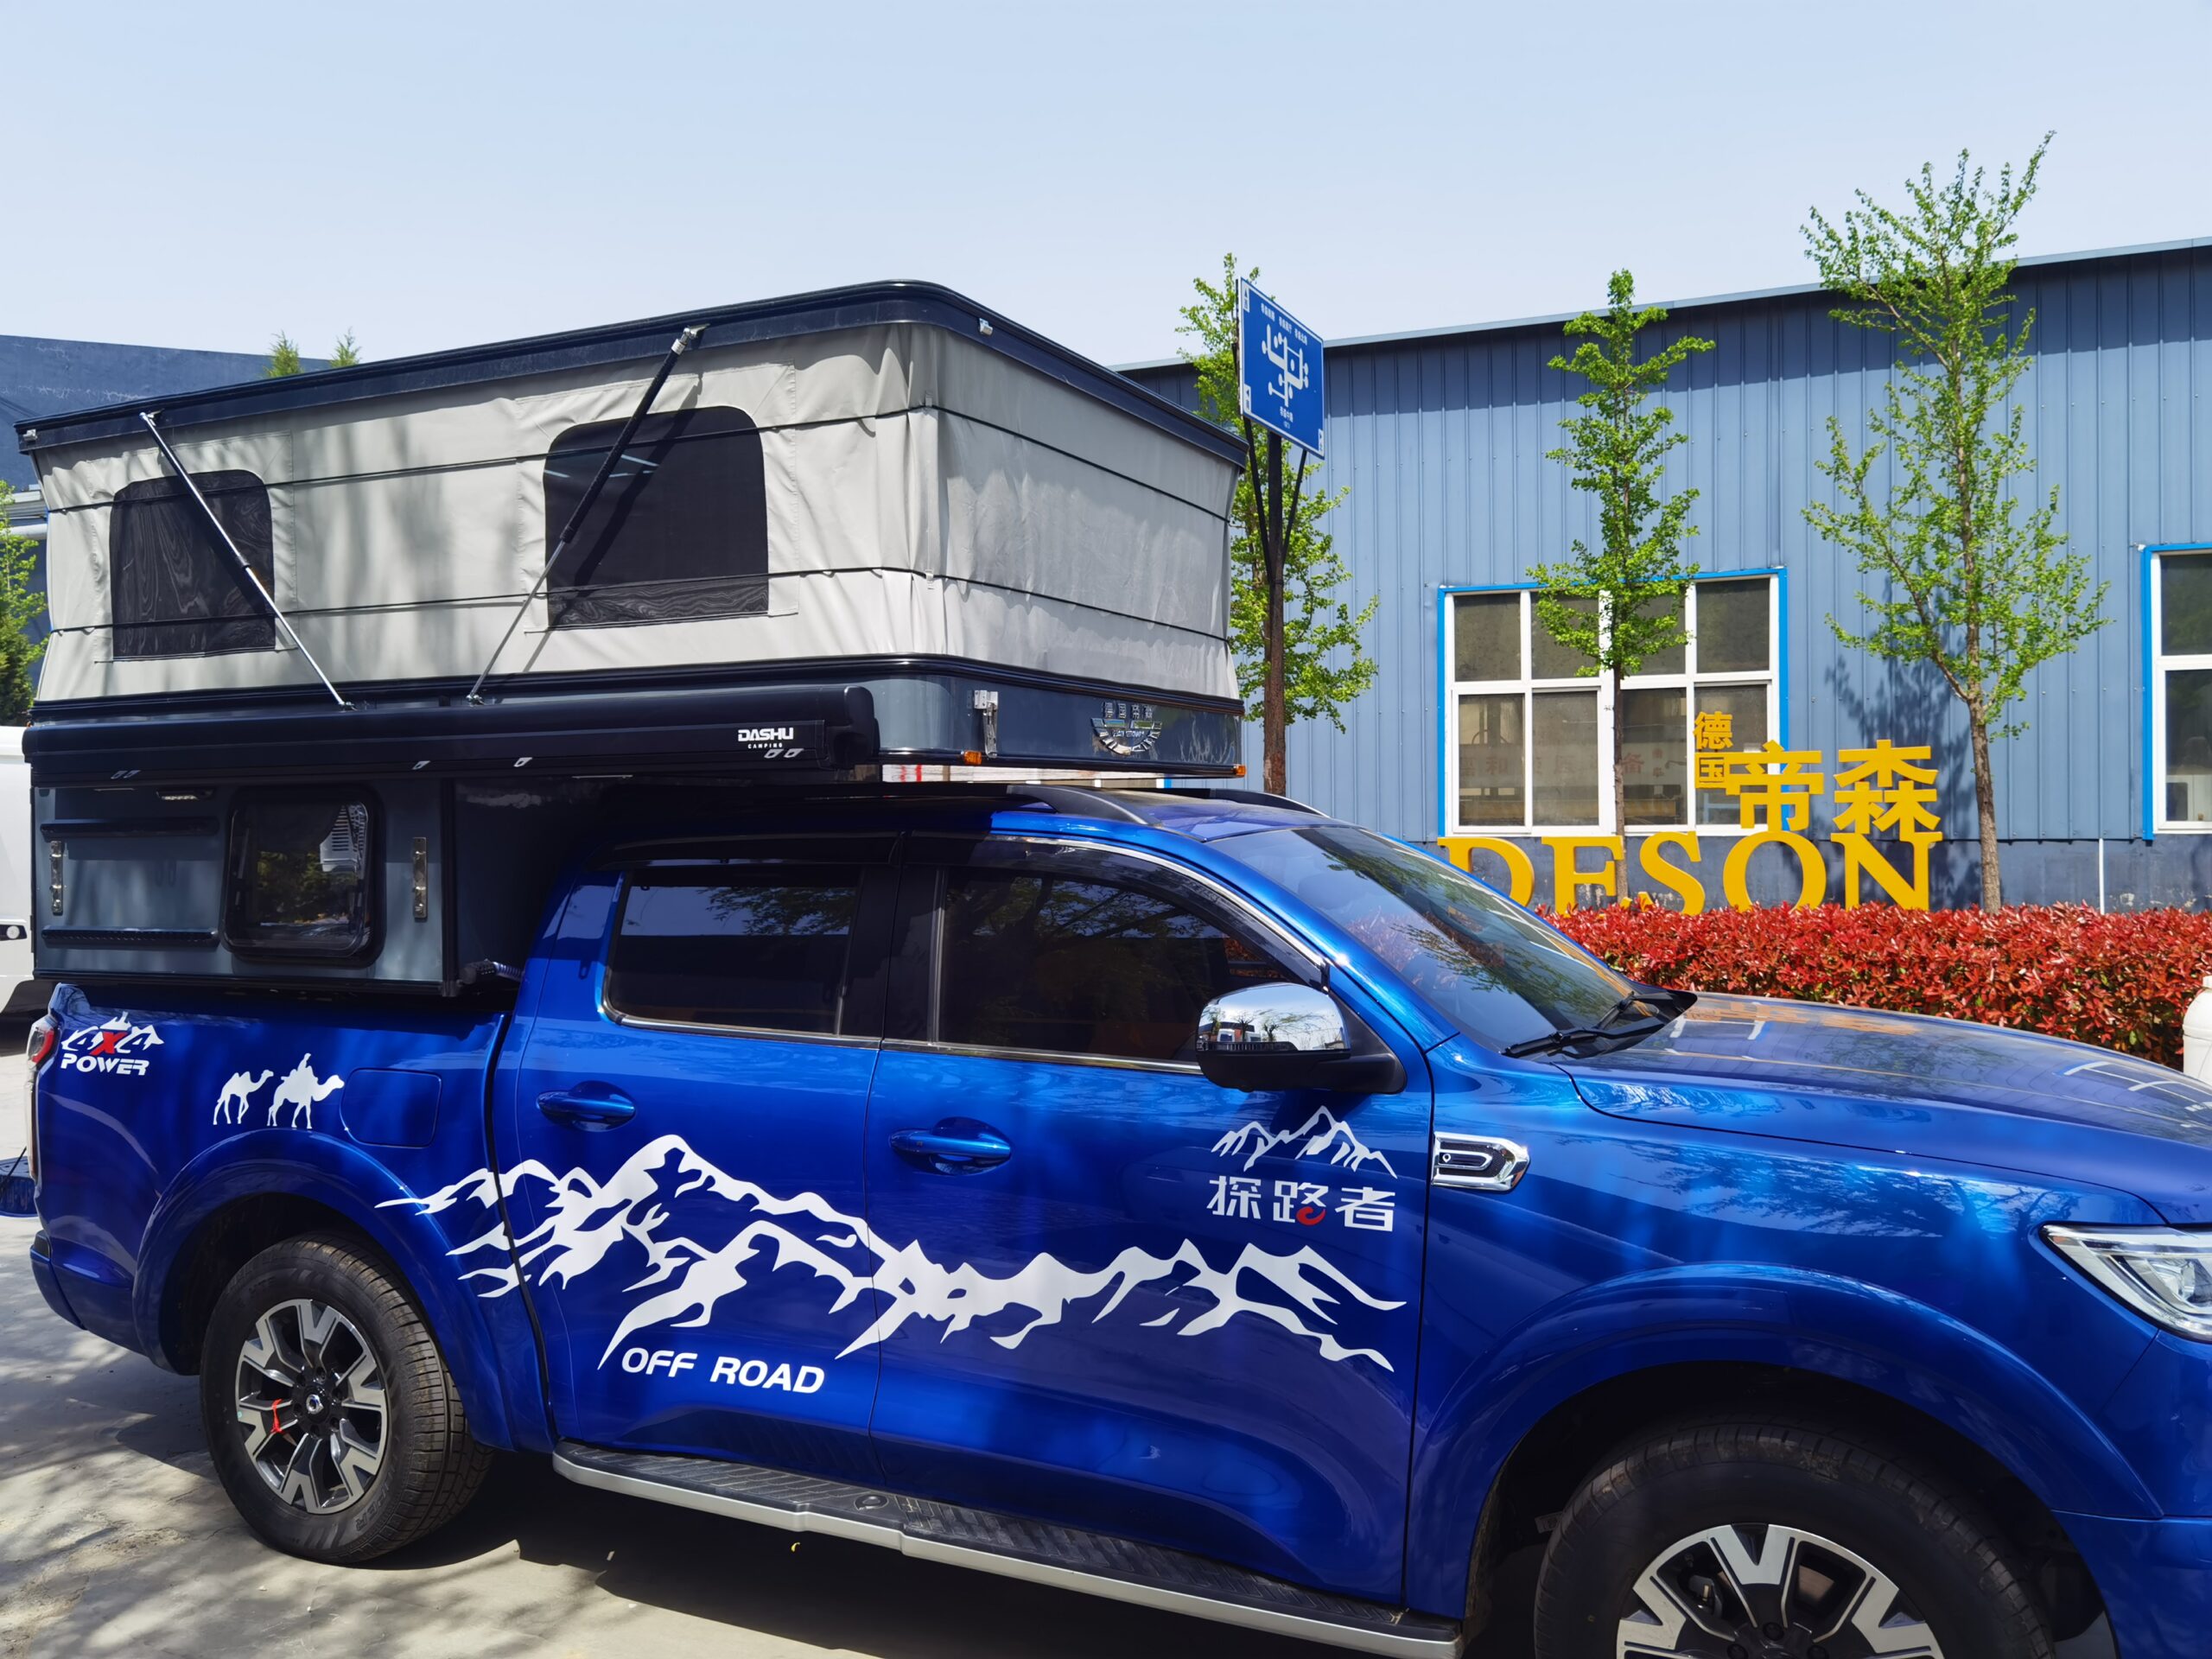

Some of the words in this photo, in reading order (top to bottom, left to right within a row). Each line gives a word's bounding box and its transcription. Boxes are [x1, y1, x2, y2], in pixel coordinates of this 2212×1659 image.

[738, 728, 794, 742] DASHU
[1693, 710, 1733, 789] 德国
[1726, 739, 1939, 834] 帝森
[1437, 830, 1943, 916] DESON
[60, 1052, 150, 1077] POWER
[1206, 1175, 1396, 1232] 探路者
[621, 1347, 698, 1377] OFF
[709, 1356, 826, 1394] ROAD
